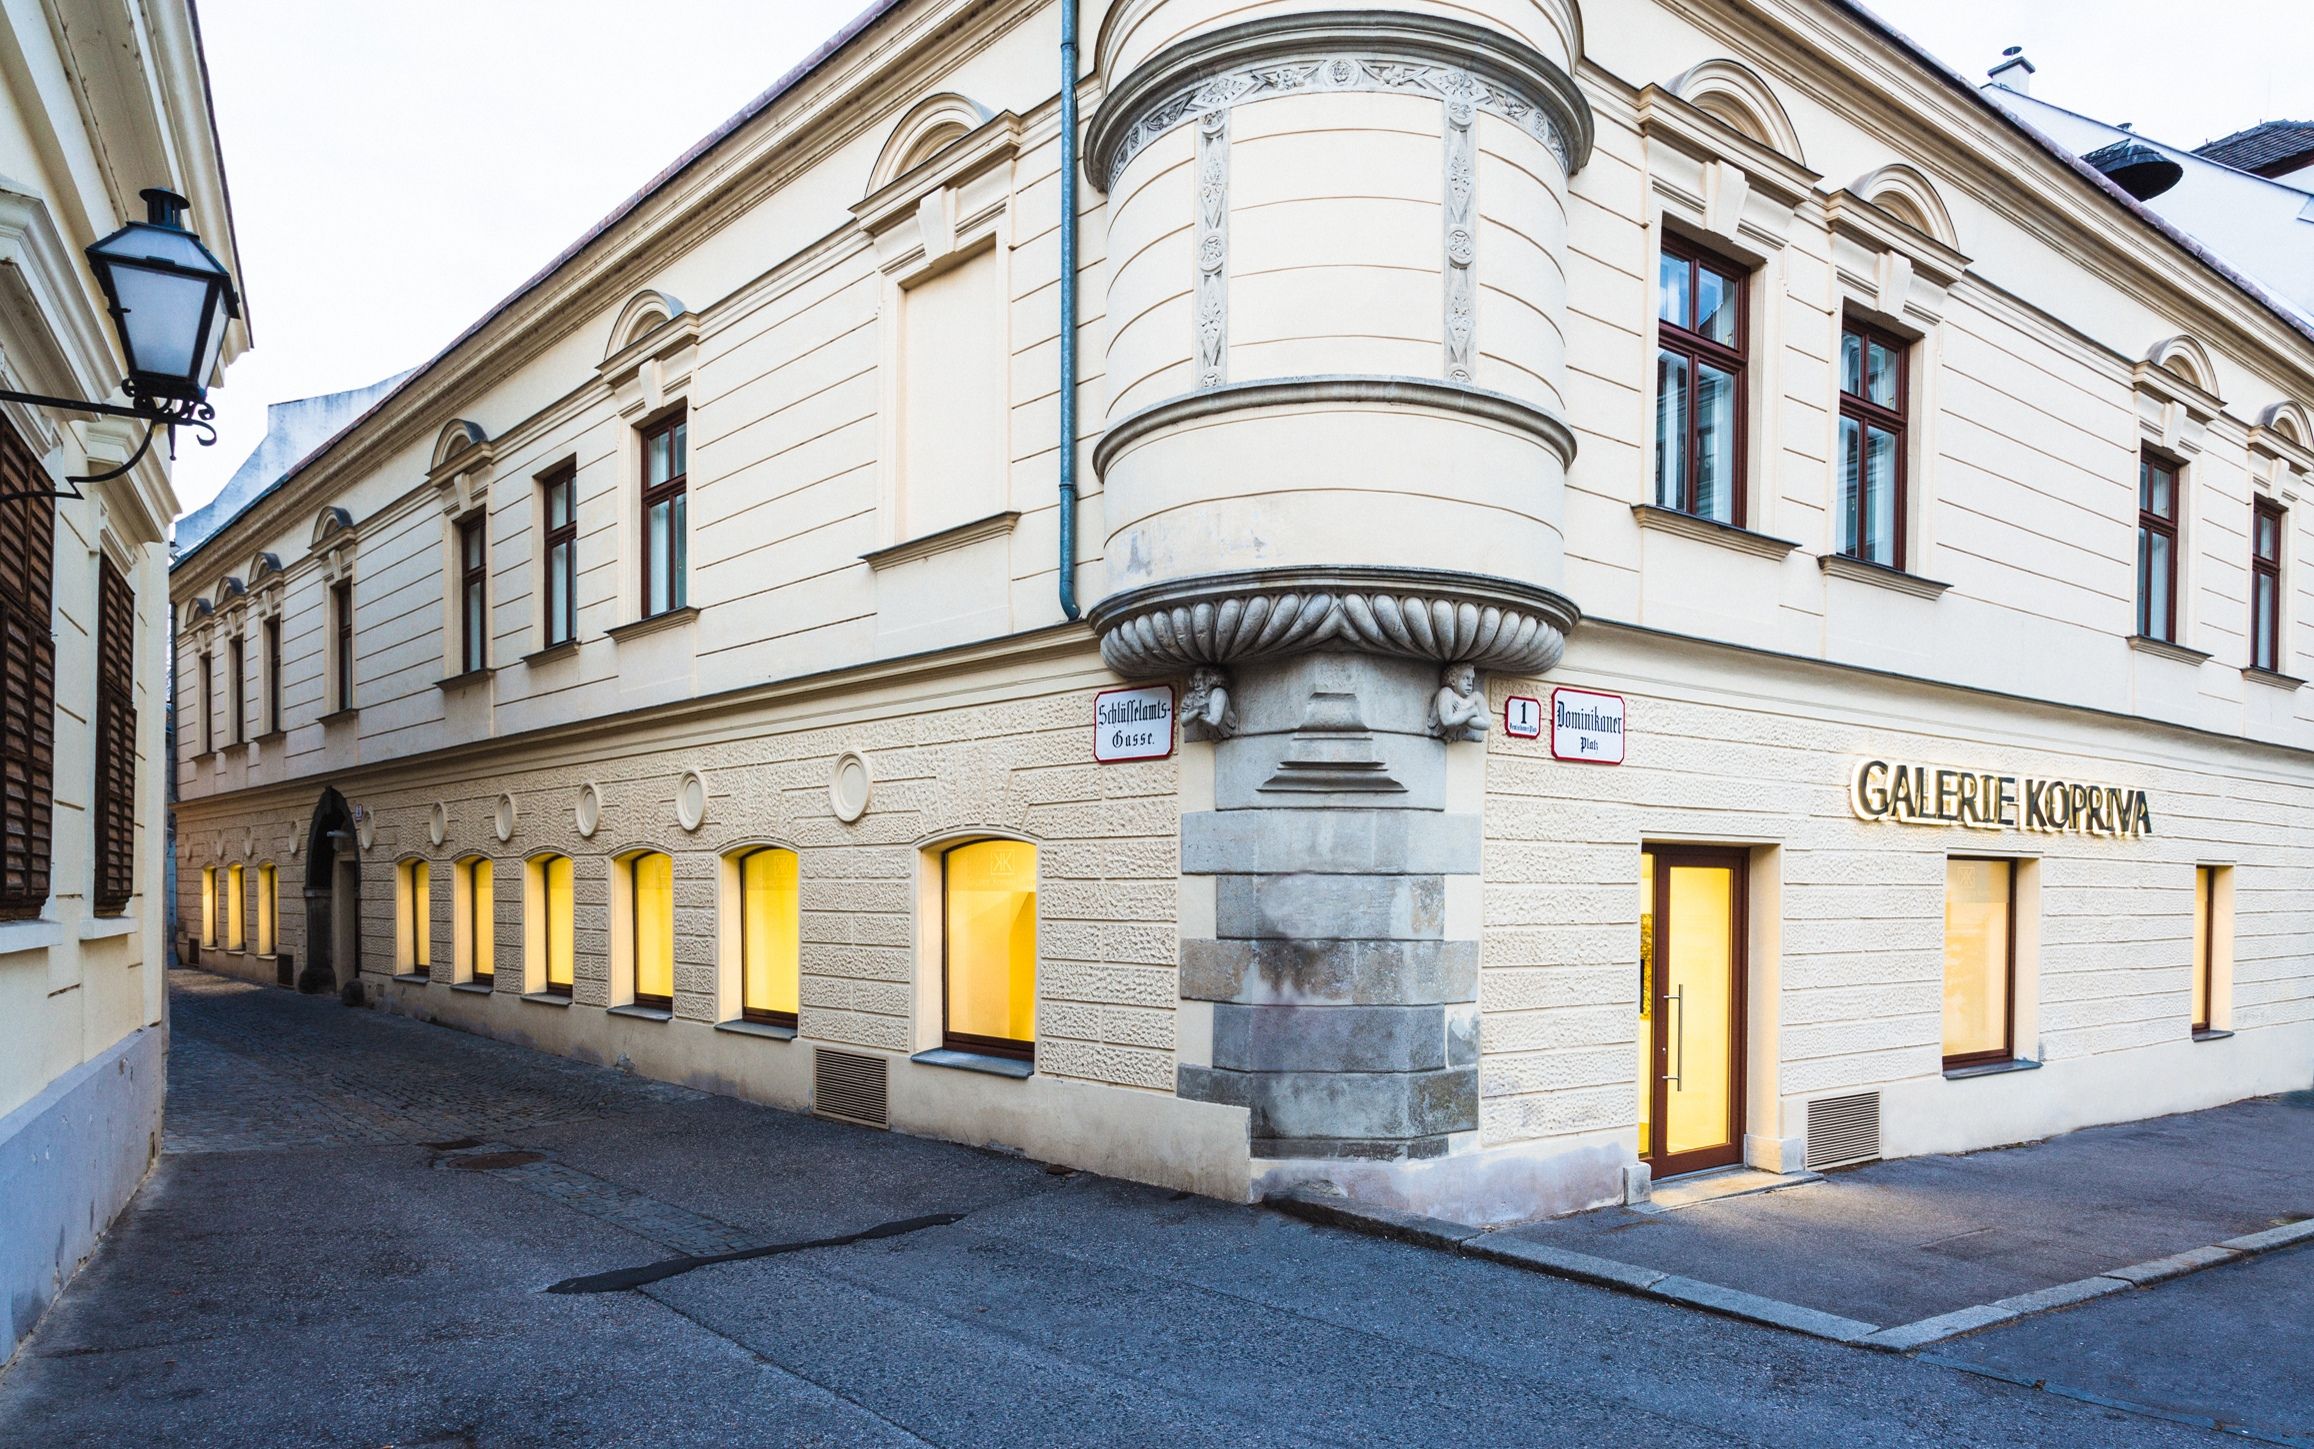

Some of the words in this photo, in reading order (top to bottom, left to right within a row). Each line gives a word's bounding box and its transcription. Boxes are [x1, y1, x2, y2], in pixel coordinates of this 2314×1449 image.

[1520, 701, 1527, 724] 1
[1556, 701, 1622, 734] Dominikaner
[1857, 760, 2015, 826] GALERIE
[2025, 779, 2152, 833] KOPRIVA
